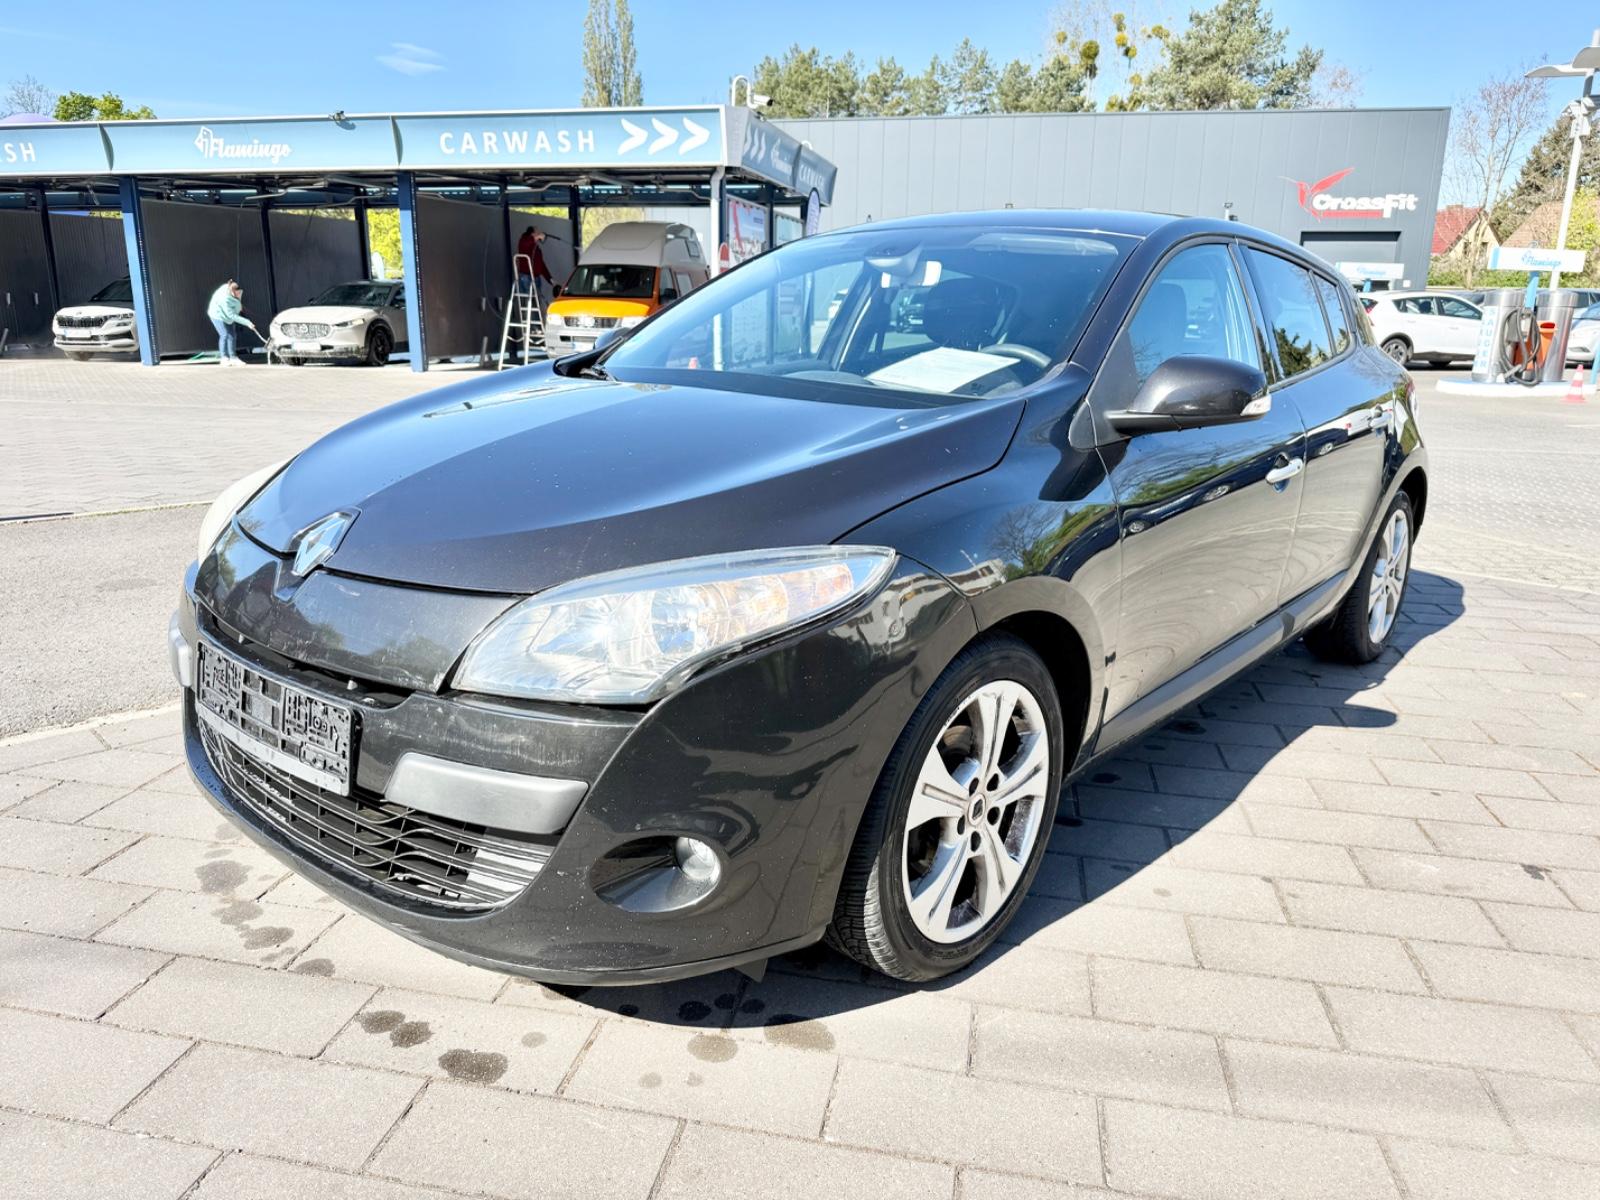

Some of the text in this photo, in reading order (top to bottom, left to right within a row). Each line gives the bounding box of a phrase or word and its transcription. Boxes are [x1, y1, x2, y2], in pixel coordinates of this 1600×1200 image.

[0, 142, 36, 162] SH
[209, 137, 293, 164] Flamingo
[439, 130, 595, 155] CARWASH
[1312, 193, 1419, 218] CrossFit
